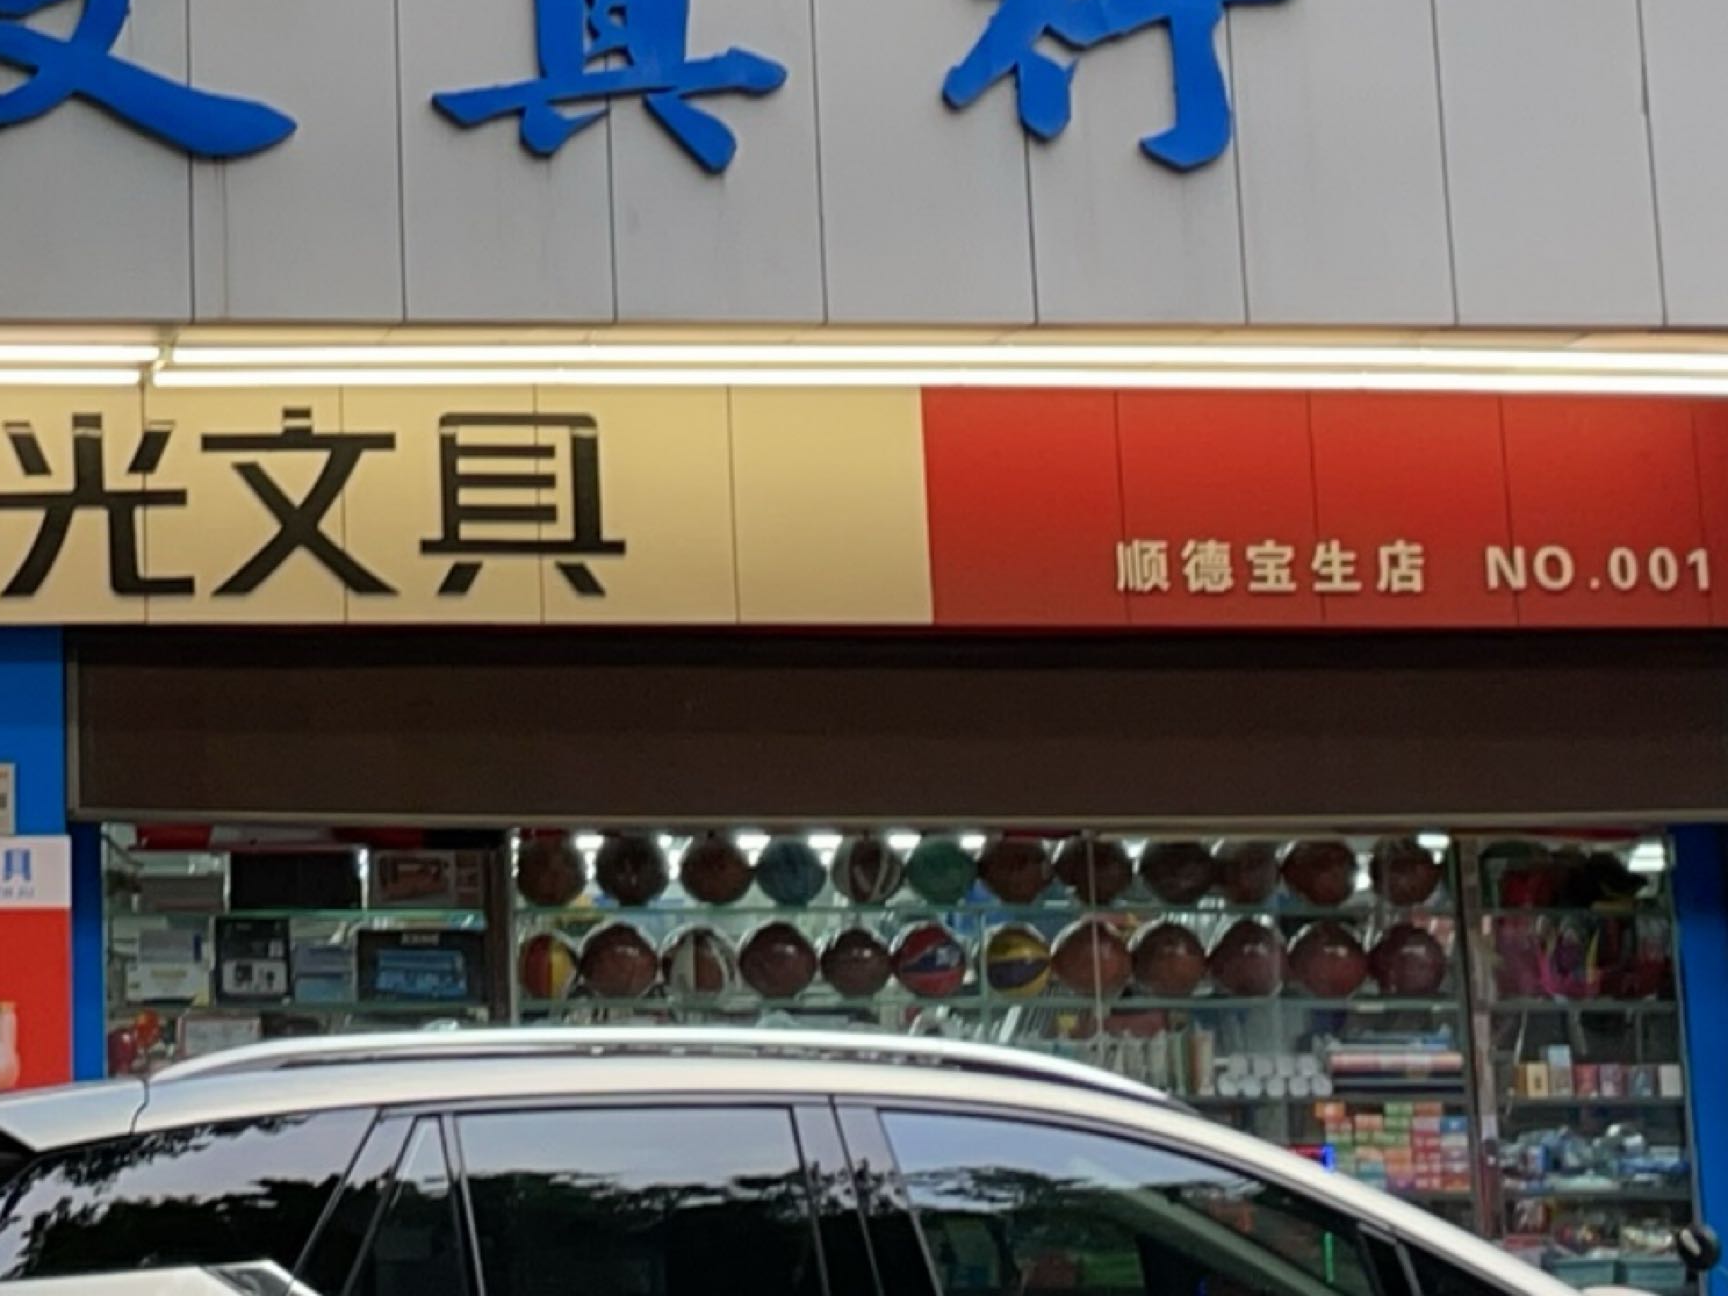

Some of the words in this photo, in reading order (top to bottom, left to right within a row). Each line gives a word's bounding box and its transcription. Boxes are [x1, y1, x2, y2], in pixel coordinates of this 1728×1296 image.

[1116, 539, 1425, 593] 顺德宝生店
[1485, 545, 1710, 591] NO.001
